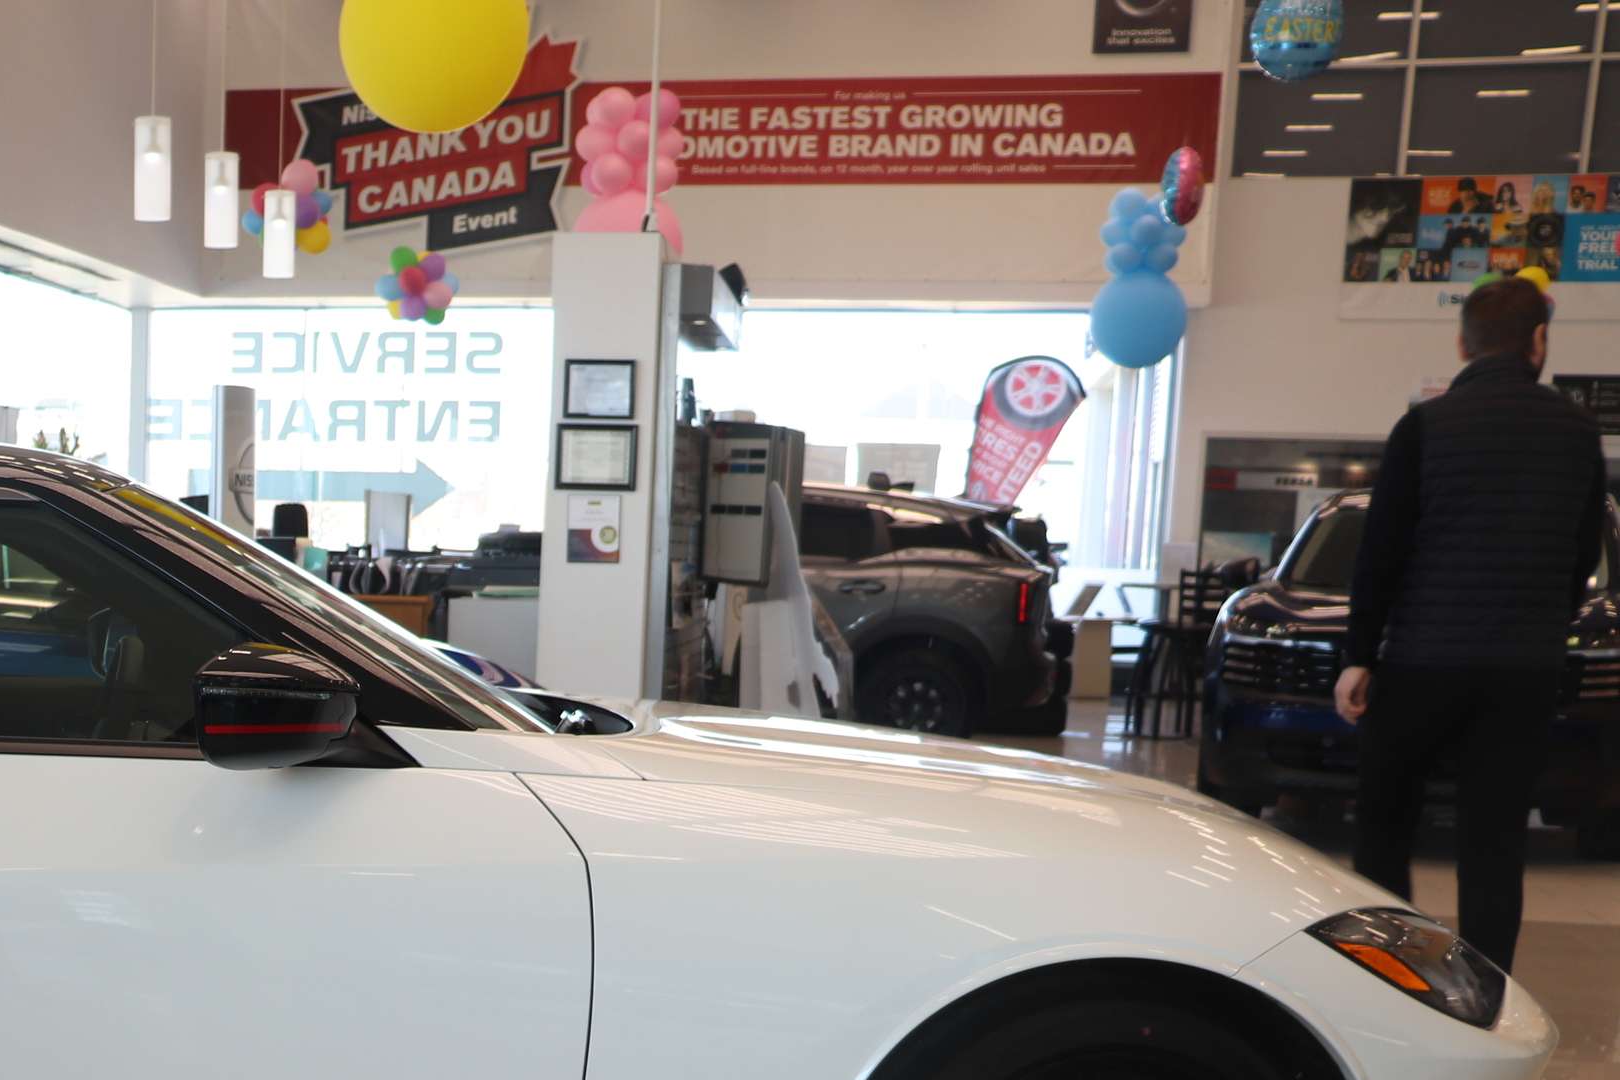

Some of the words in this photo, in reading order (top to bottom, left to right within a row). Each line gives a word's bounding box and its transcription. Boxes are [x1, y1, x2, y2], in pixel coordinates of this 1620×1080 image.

[834, 91, 851, 100] For
[853, 91, 890, 101] making
[341, 104, 379, 126] Nis
[680, 107, 741, 131] THE
[749, 105, 892, 130] FASTEST
[899, 103, 1064, 129] GROWING
[341, 132, 467, 174] THANK
[471, 108, 551, 149] YOU
[678, 134, 819, 160] OMOTIVE
[828, 133, 942, 159] BRAND
[949, 133, 984, 157] IN
[992, 131, 1137, 157] CANADA
[357, 160, 516, 214] CANADA
[451, 206, 518, 234] Event
[234, 473, 254, 488] NIS
